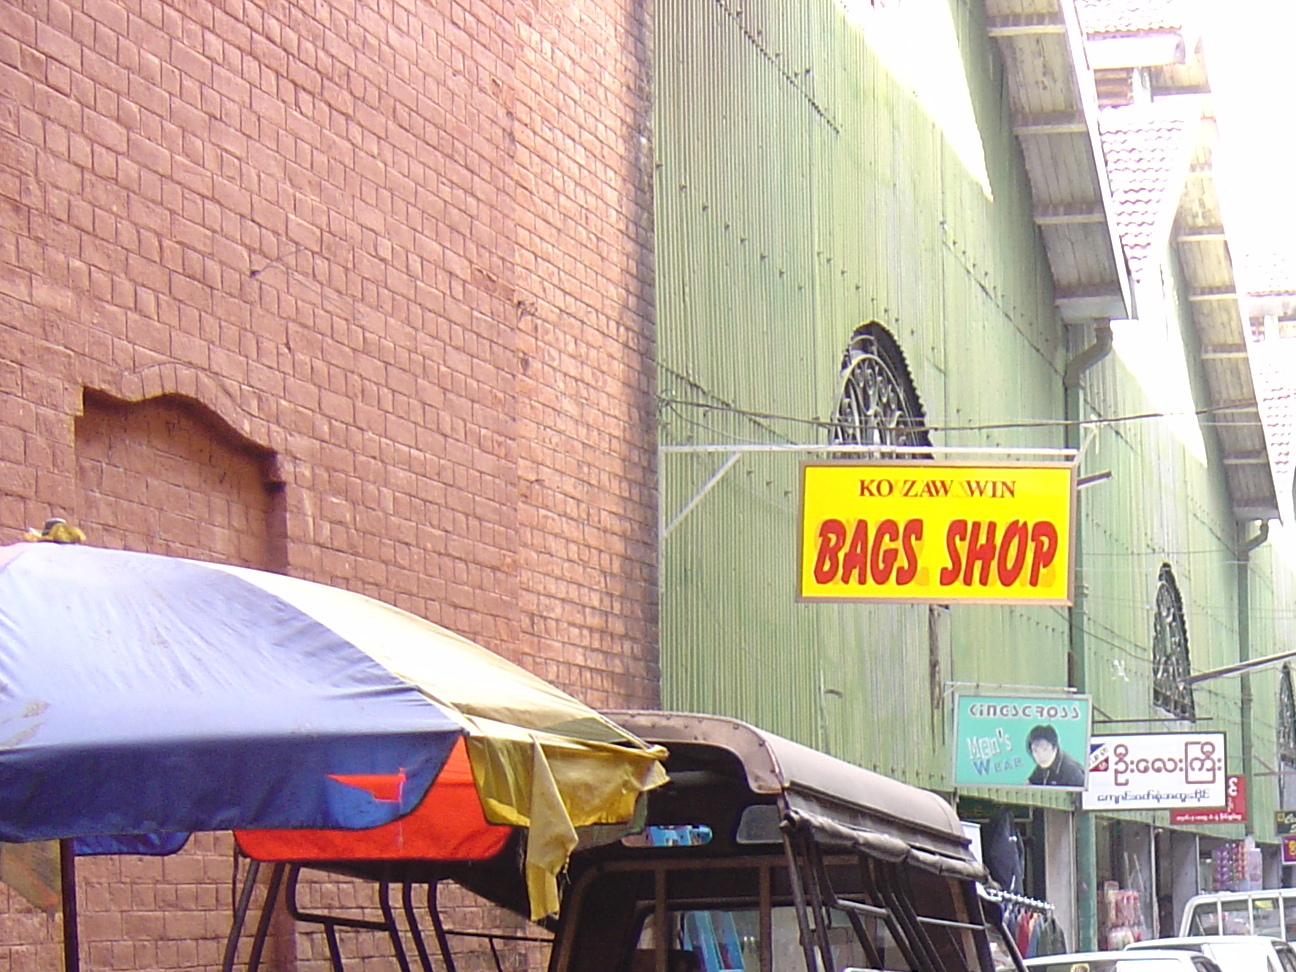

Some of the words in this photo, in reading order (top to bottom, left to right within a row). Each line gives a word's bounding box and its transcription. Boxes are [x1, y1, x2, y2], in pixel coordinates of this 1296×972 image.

[858, 479, 894, 498] KO
[903, 479, 954, 498] ZAW
[964, 480, 1017, 499] WIN
[813, 517, 924, 586] BAGS
[939, 518, 1058, 588] SHOP
